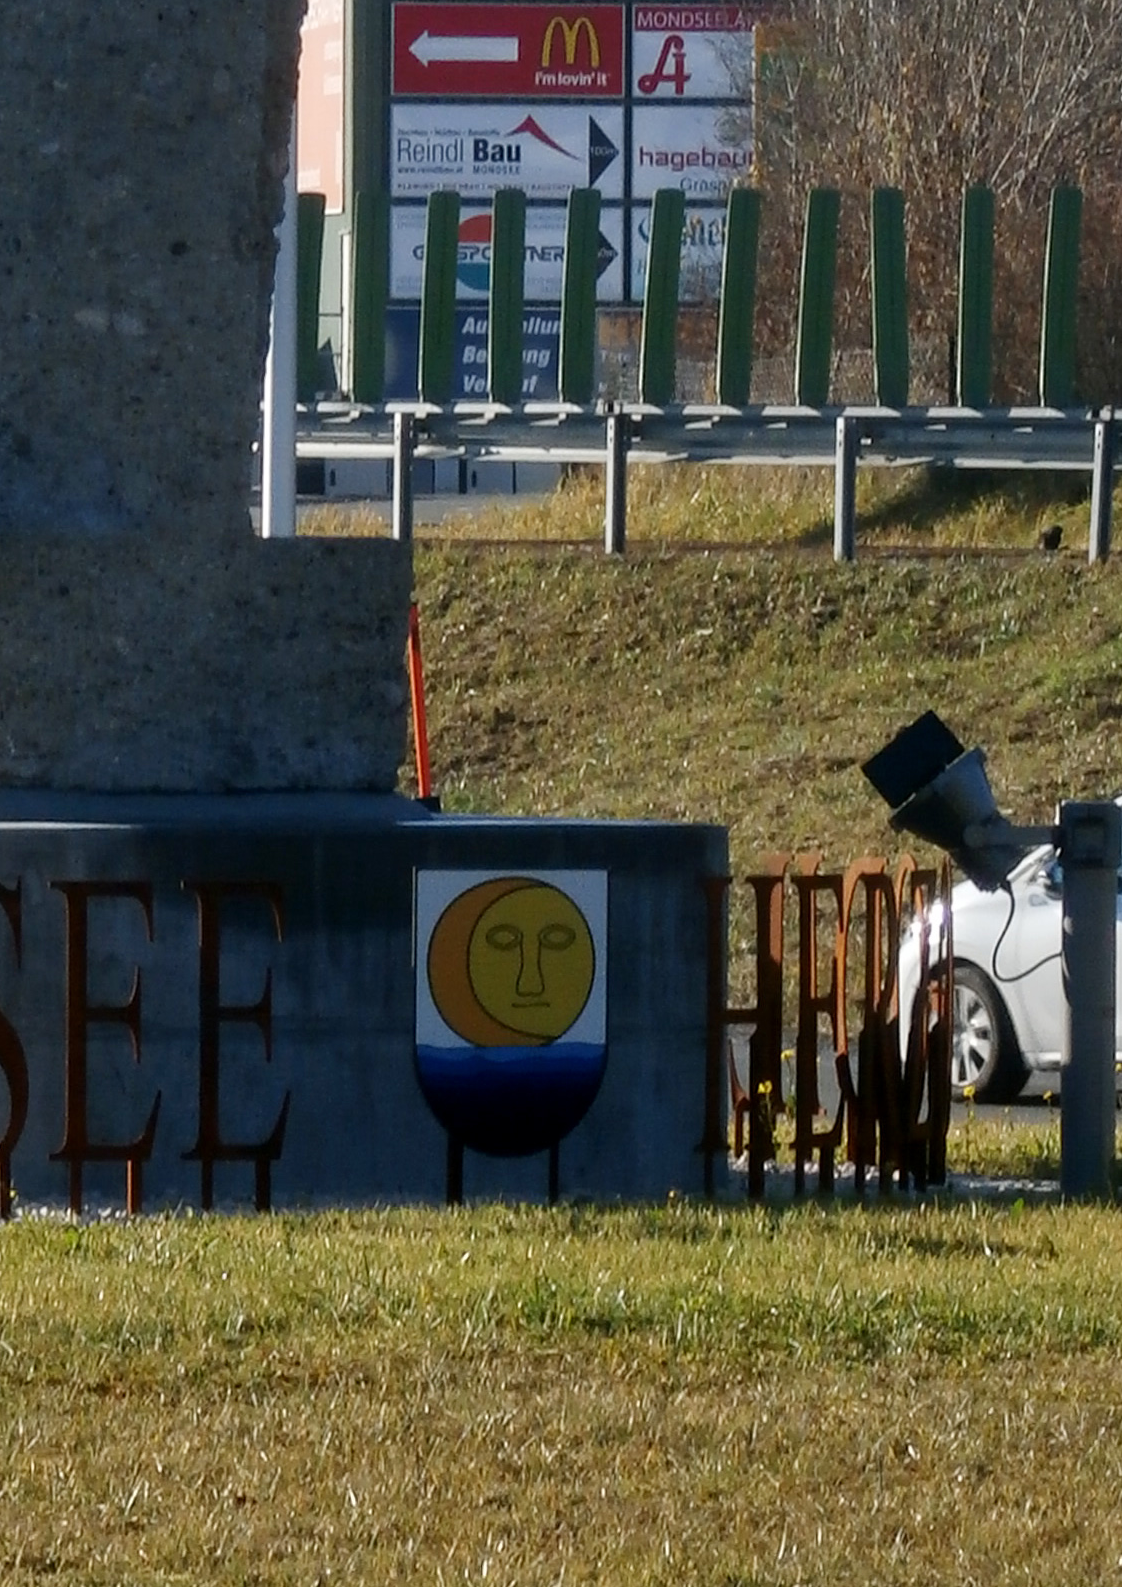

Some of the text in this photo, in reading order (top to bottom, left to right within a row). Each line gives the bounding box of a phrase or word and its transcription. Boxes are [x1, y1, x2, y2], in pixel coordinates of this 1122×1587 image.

[535, 71, 556, 85] I'm
[597, 72, 608, 86] it
[397, 137, 521, 163] Reindl Bau
